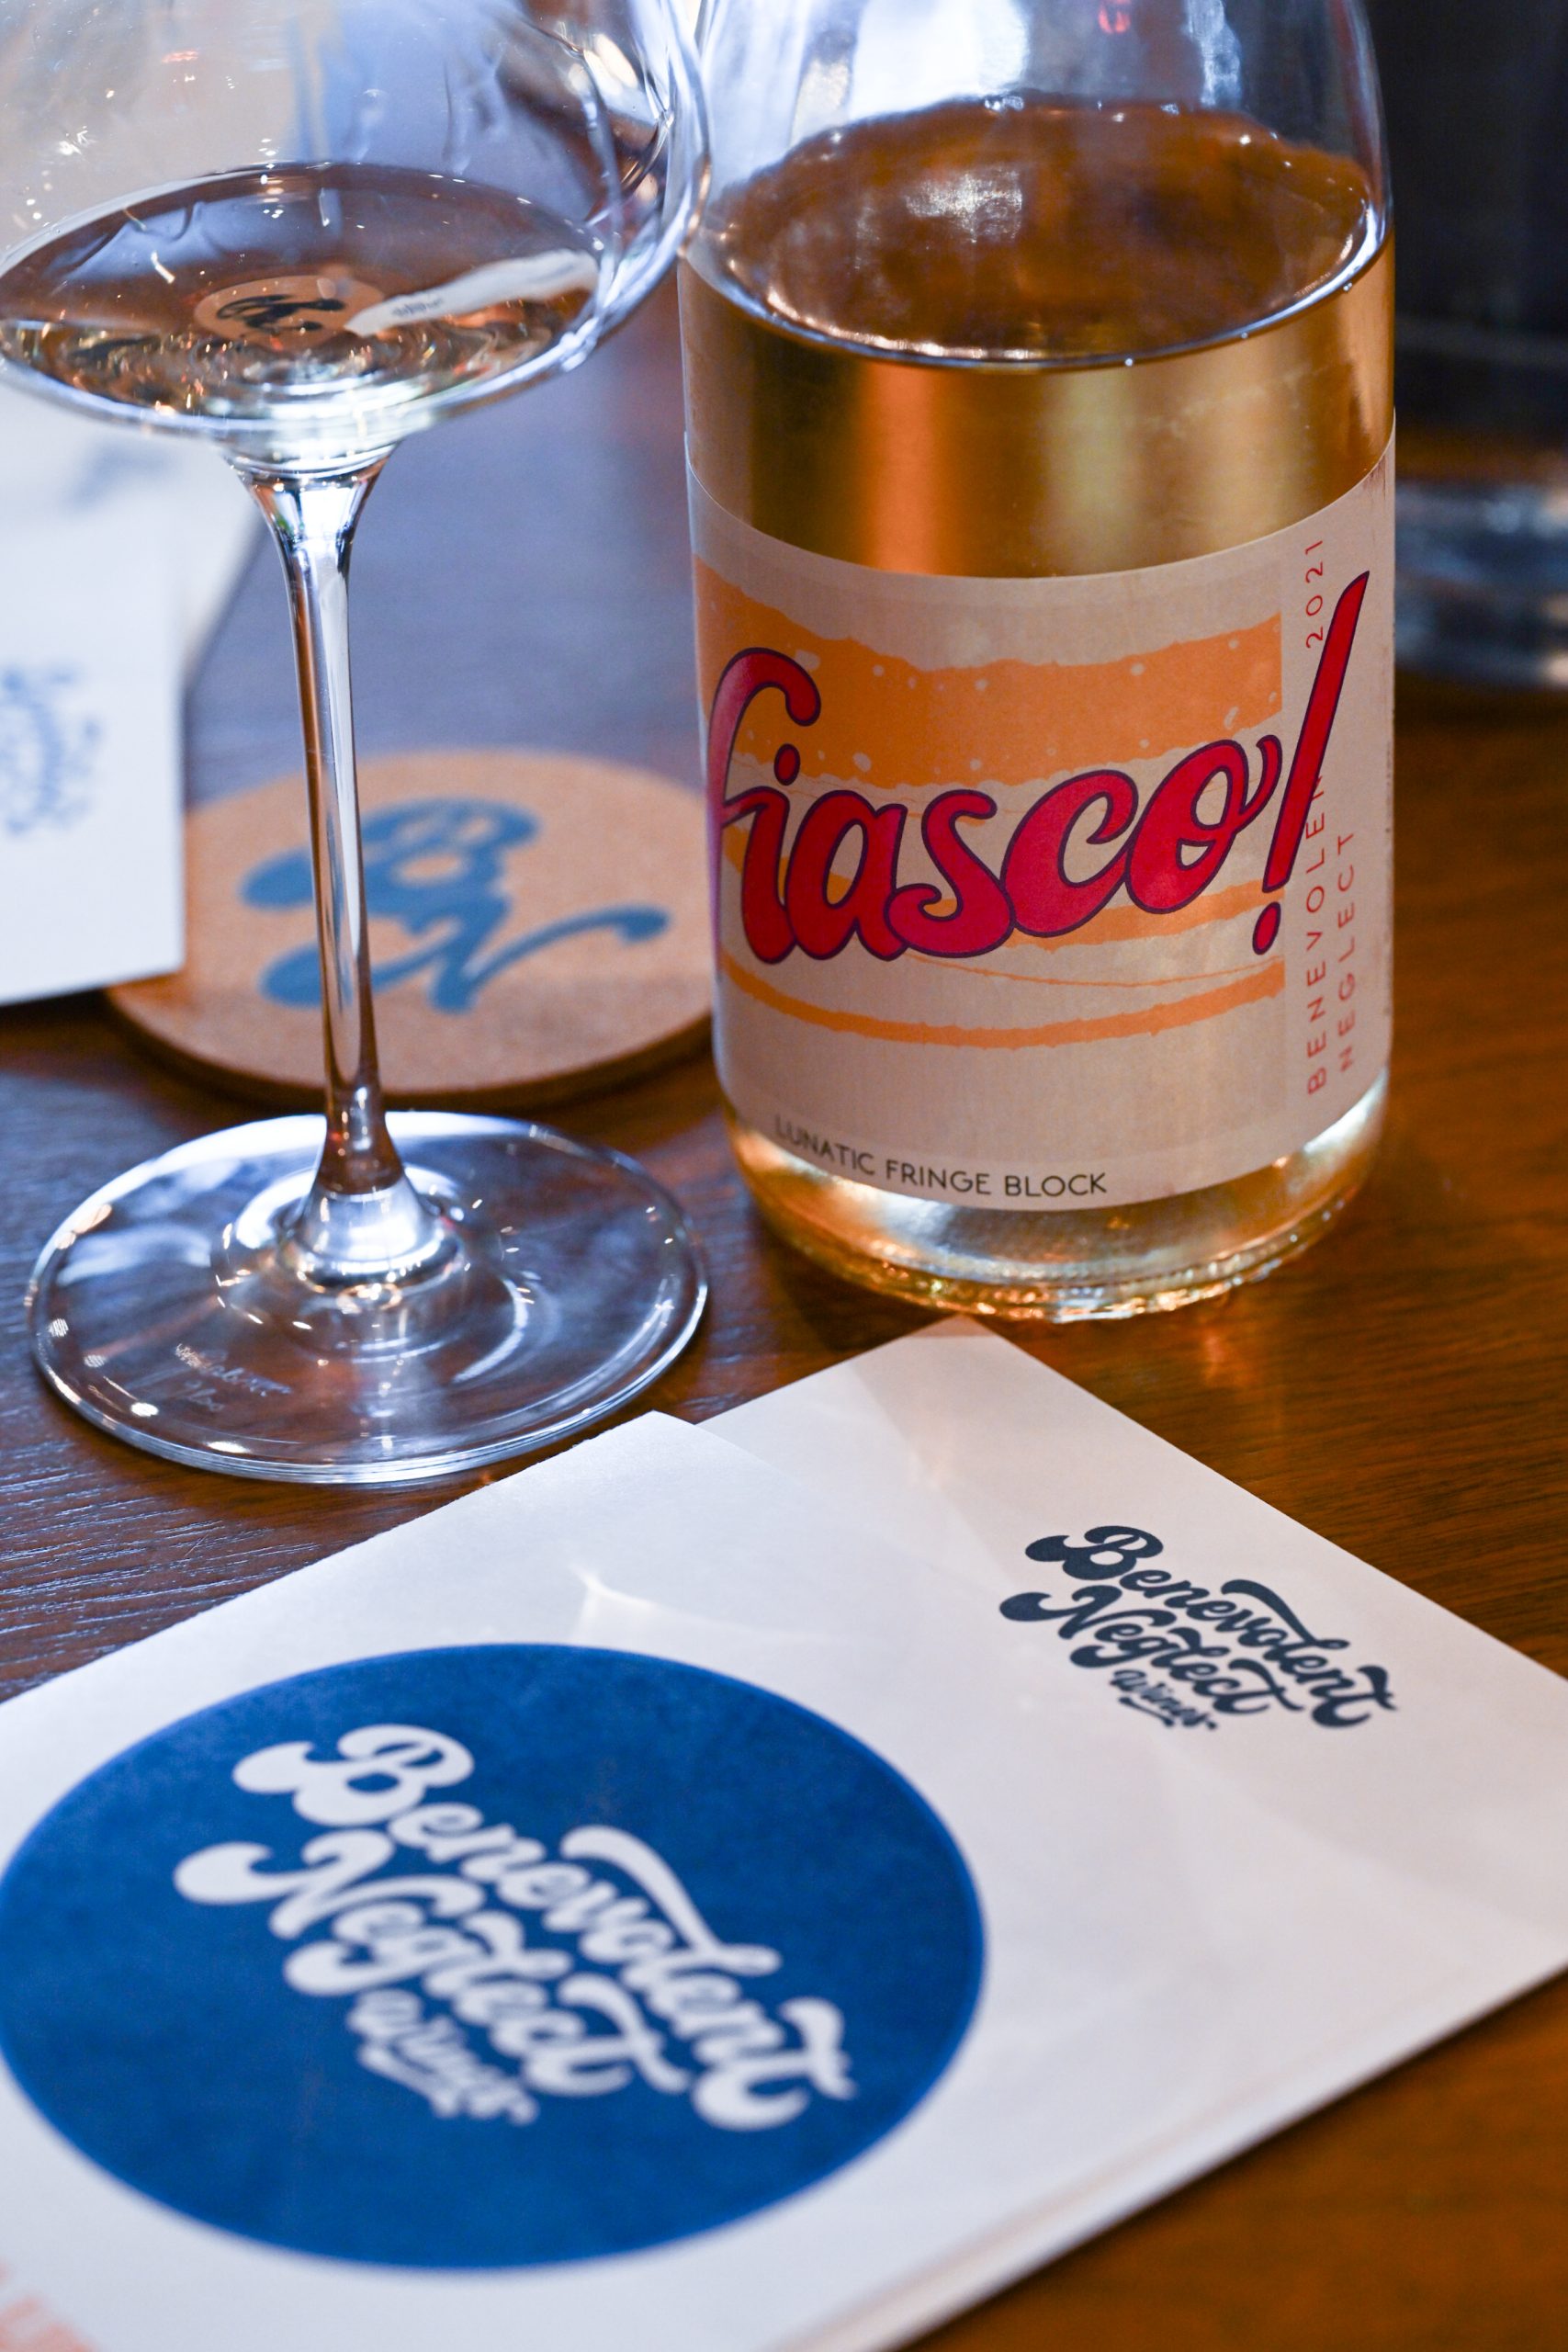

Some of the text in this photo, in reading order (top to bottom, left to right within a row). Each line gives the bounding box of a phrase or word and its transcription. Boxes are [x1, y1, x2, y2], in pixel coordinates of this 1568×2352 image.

[1304, 539, 1325, 650] 2021
[1337, 833, 1356, 1072] NEGLECT
[774, 1114, 1108, 1197] LUNATIC FRINGE BLOCK
[998, 1584, 1305, 1715] Neglect
[1024, 1524, 1399, 1728] Benevolent
[173, 1828, 691, 2096] Neglect
[231, 1724, 858, 2131] Benevolent
